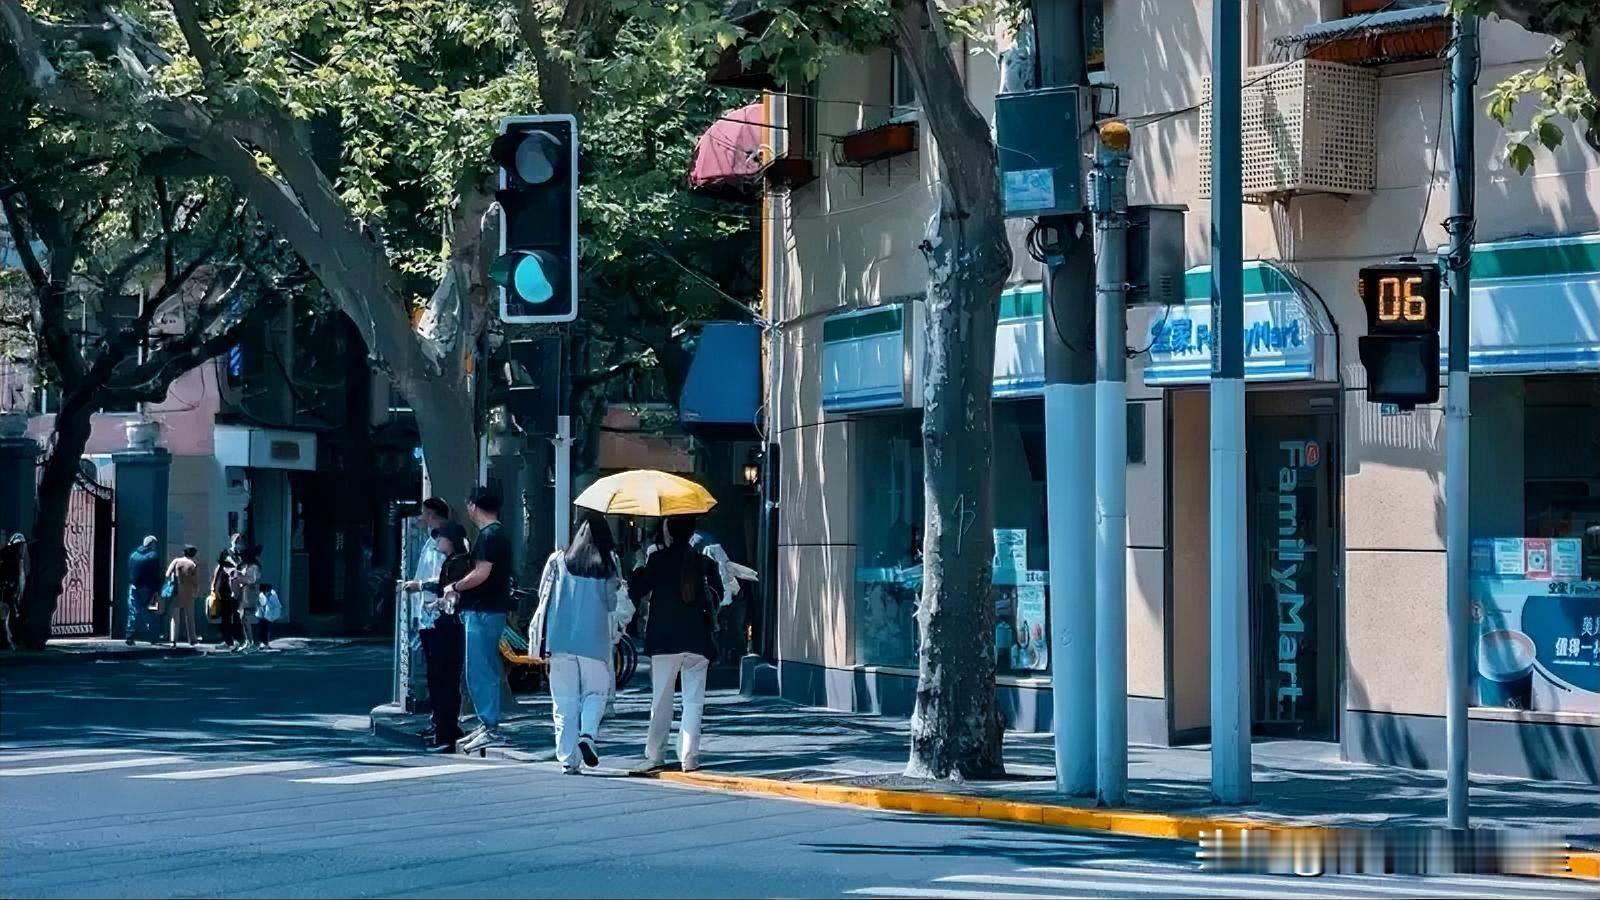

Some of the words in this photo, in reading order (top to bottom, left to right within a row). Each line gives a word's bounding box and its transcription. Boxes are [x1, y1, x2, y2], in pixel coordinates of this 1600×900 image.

[1378, 276, 1427, 321] 06
[1197, 319, 1304, 356] FyMart
[1272, 440, 1305, 704] FamilyMart
